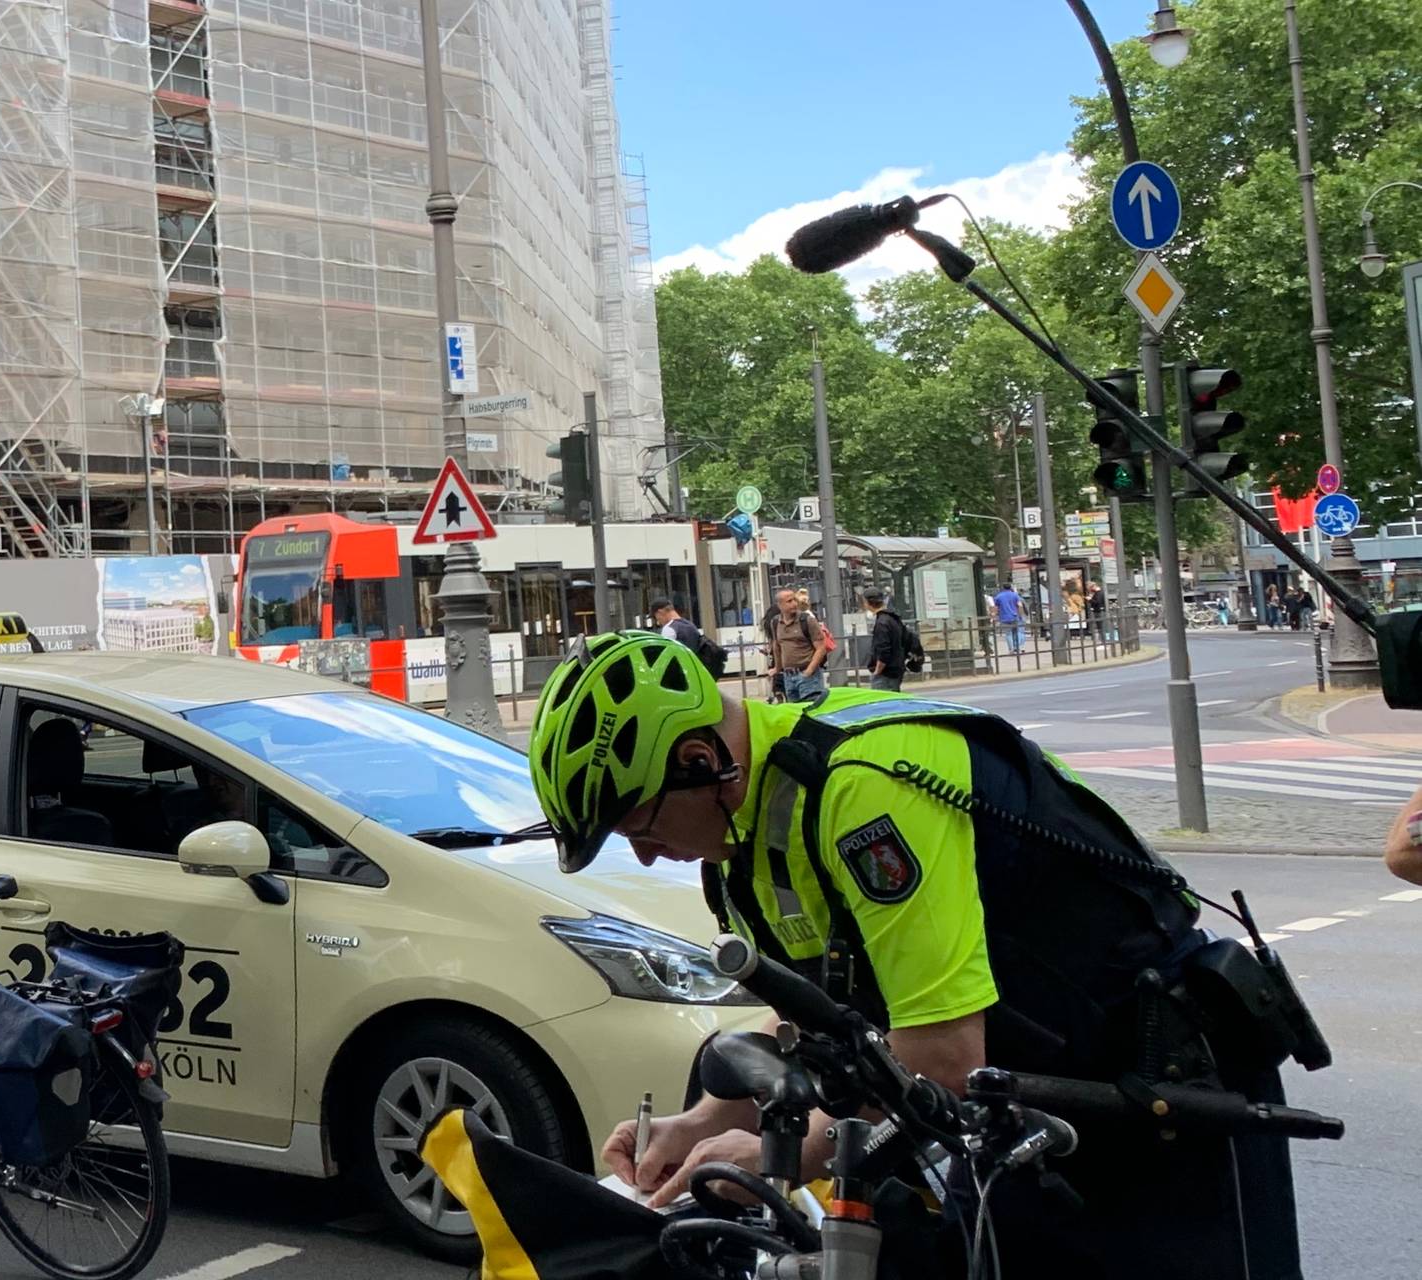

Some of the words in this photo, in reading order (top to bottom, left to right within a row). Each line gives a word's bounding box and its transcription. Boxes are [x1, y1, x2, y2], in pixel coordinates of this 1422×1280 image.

[468, 397, 527, 414] Habsburgerring
[803, 505, 814, 518] B
[1028, 513, 1036, 524] B
[258, 541, 266, 558] 7
[48, 640, 73, 650] LAGE
[592, 712, 617, 768] POLIZEI
[842, 821, 891, 855] POLIZEI
